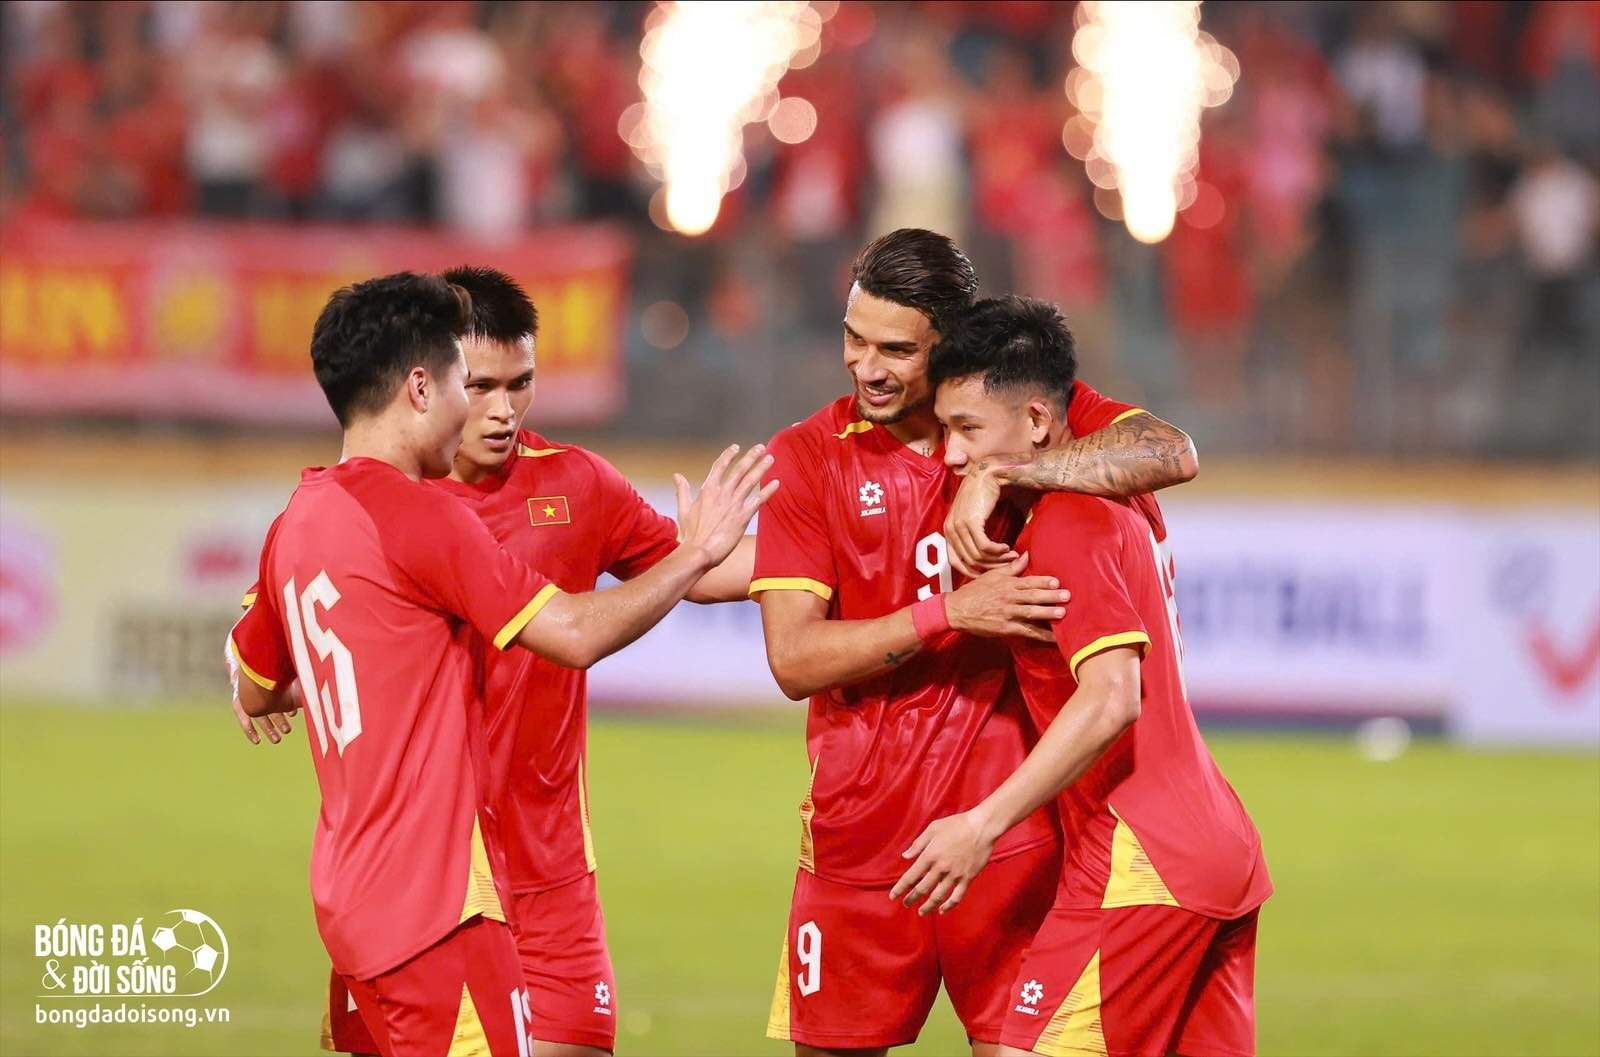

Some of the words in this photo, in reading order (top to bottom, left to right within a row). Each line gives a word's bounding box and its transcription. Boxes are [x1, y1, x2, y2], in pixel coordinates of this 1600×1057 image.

[915, 531, 953, 602] 9
[283, 568, 363, 760] 15
[797, 920, 822, 998] 9
